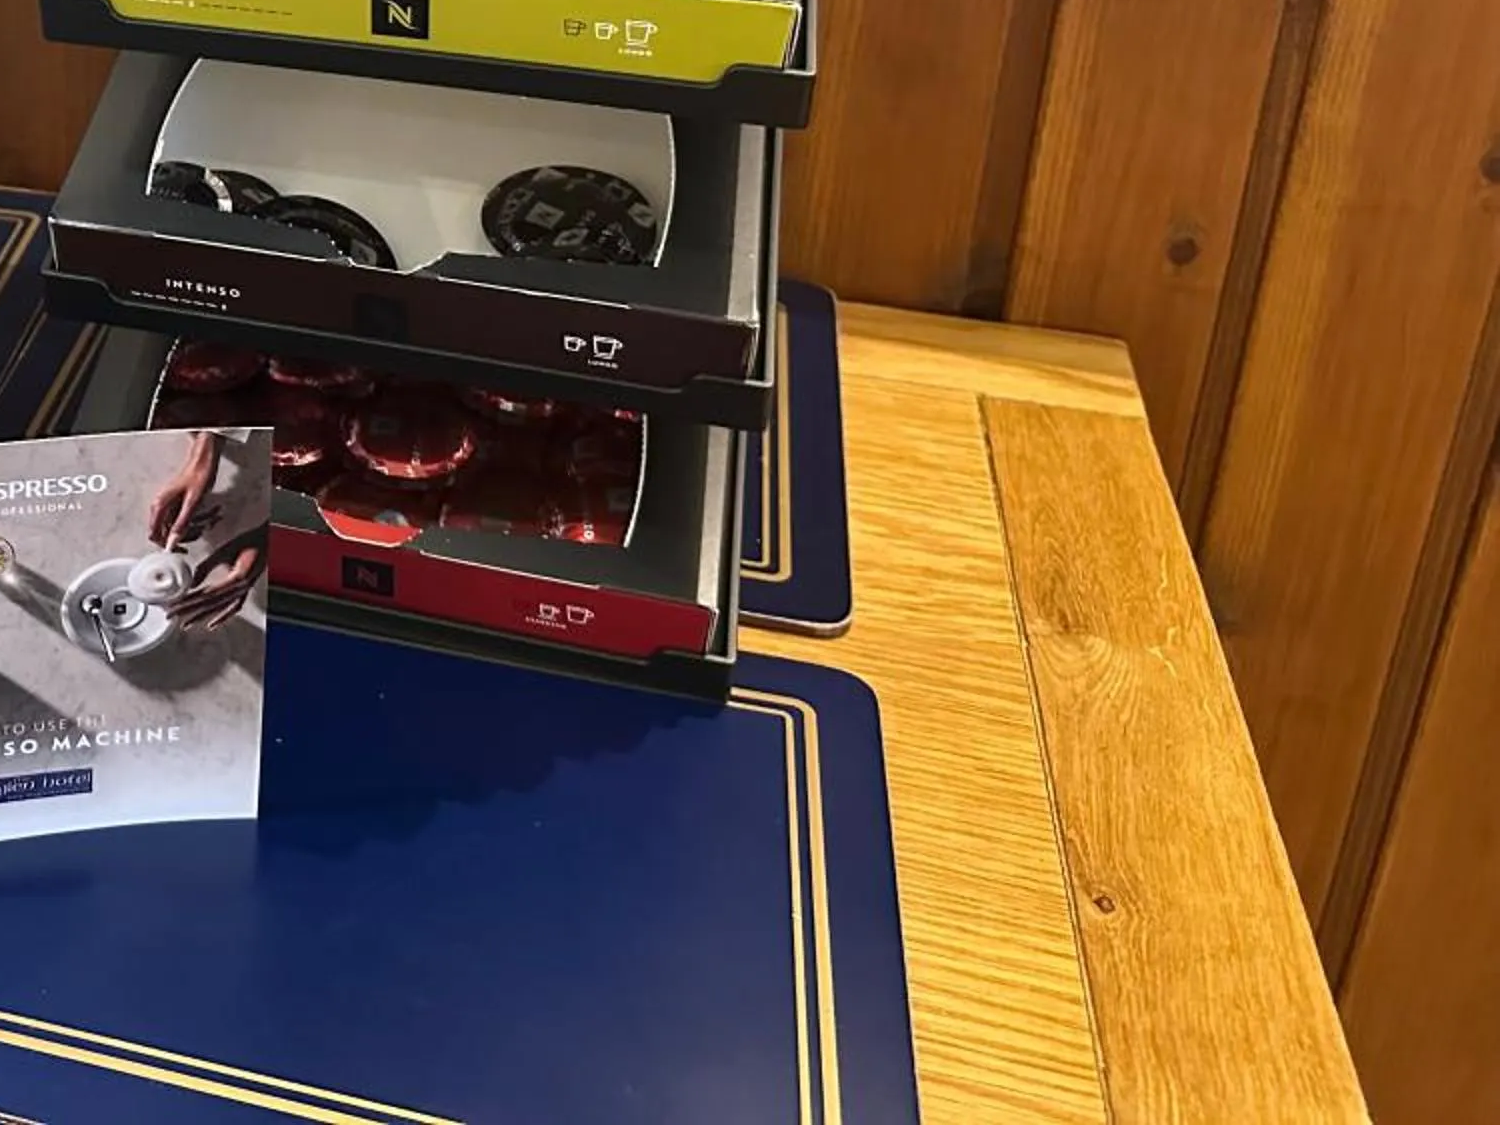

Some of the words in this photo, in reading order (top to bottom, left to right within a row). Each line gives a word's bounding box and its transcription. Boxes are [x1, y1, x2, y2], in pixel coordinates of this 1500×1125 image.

[383, 0, 417, 30] N
[165, 277, 241, 298] INTENSO
[3, 722, 25, 737] TO
[33, 718, 68, 732] USE
[51, 725, 182, 753] MACHINE
